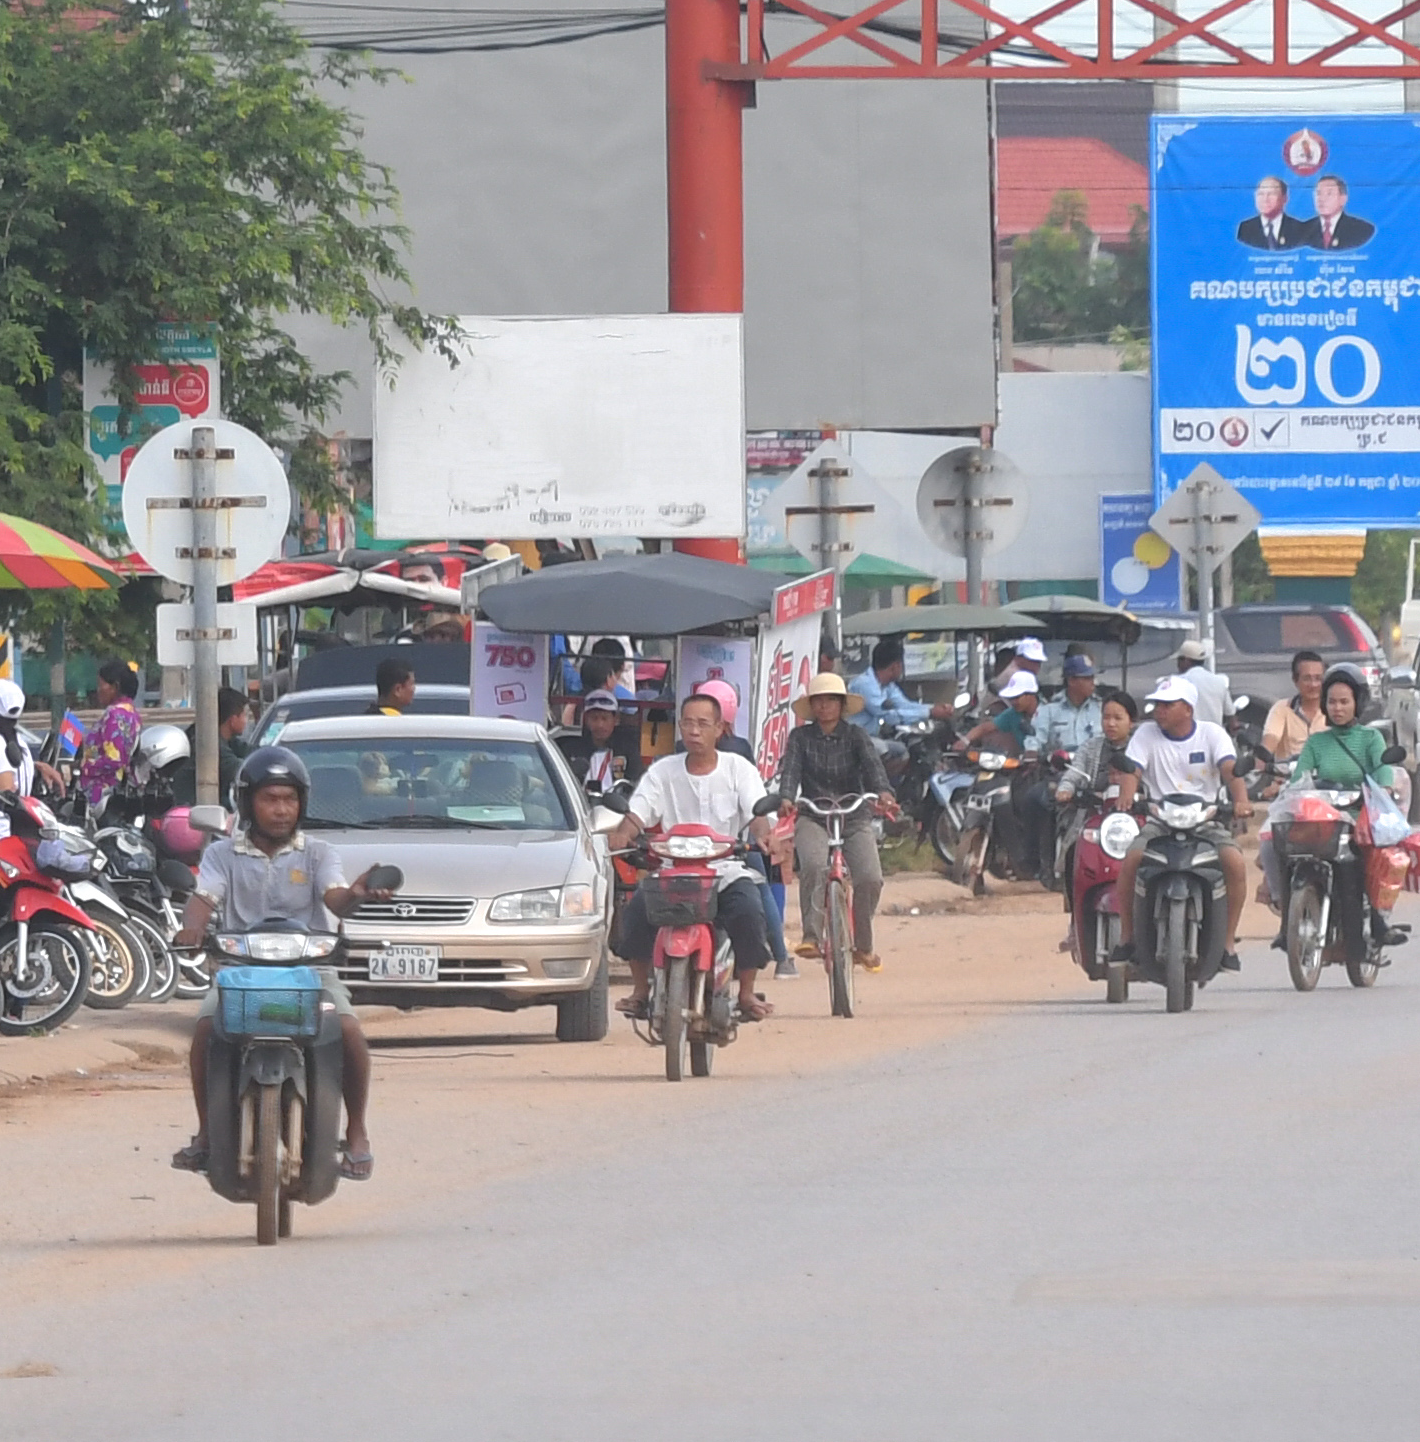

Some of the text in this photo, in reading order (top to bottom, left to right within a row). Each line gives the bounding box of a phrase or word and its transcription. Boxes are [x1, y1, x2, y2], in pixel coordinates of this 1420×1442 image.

[1235, 324, 1381, 406] ២០
[1172, 418, 1215, 442] ២០
[485, 644, 536, 669] 750
